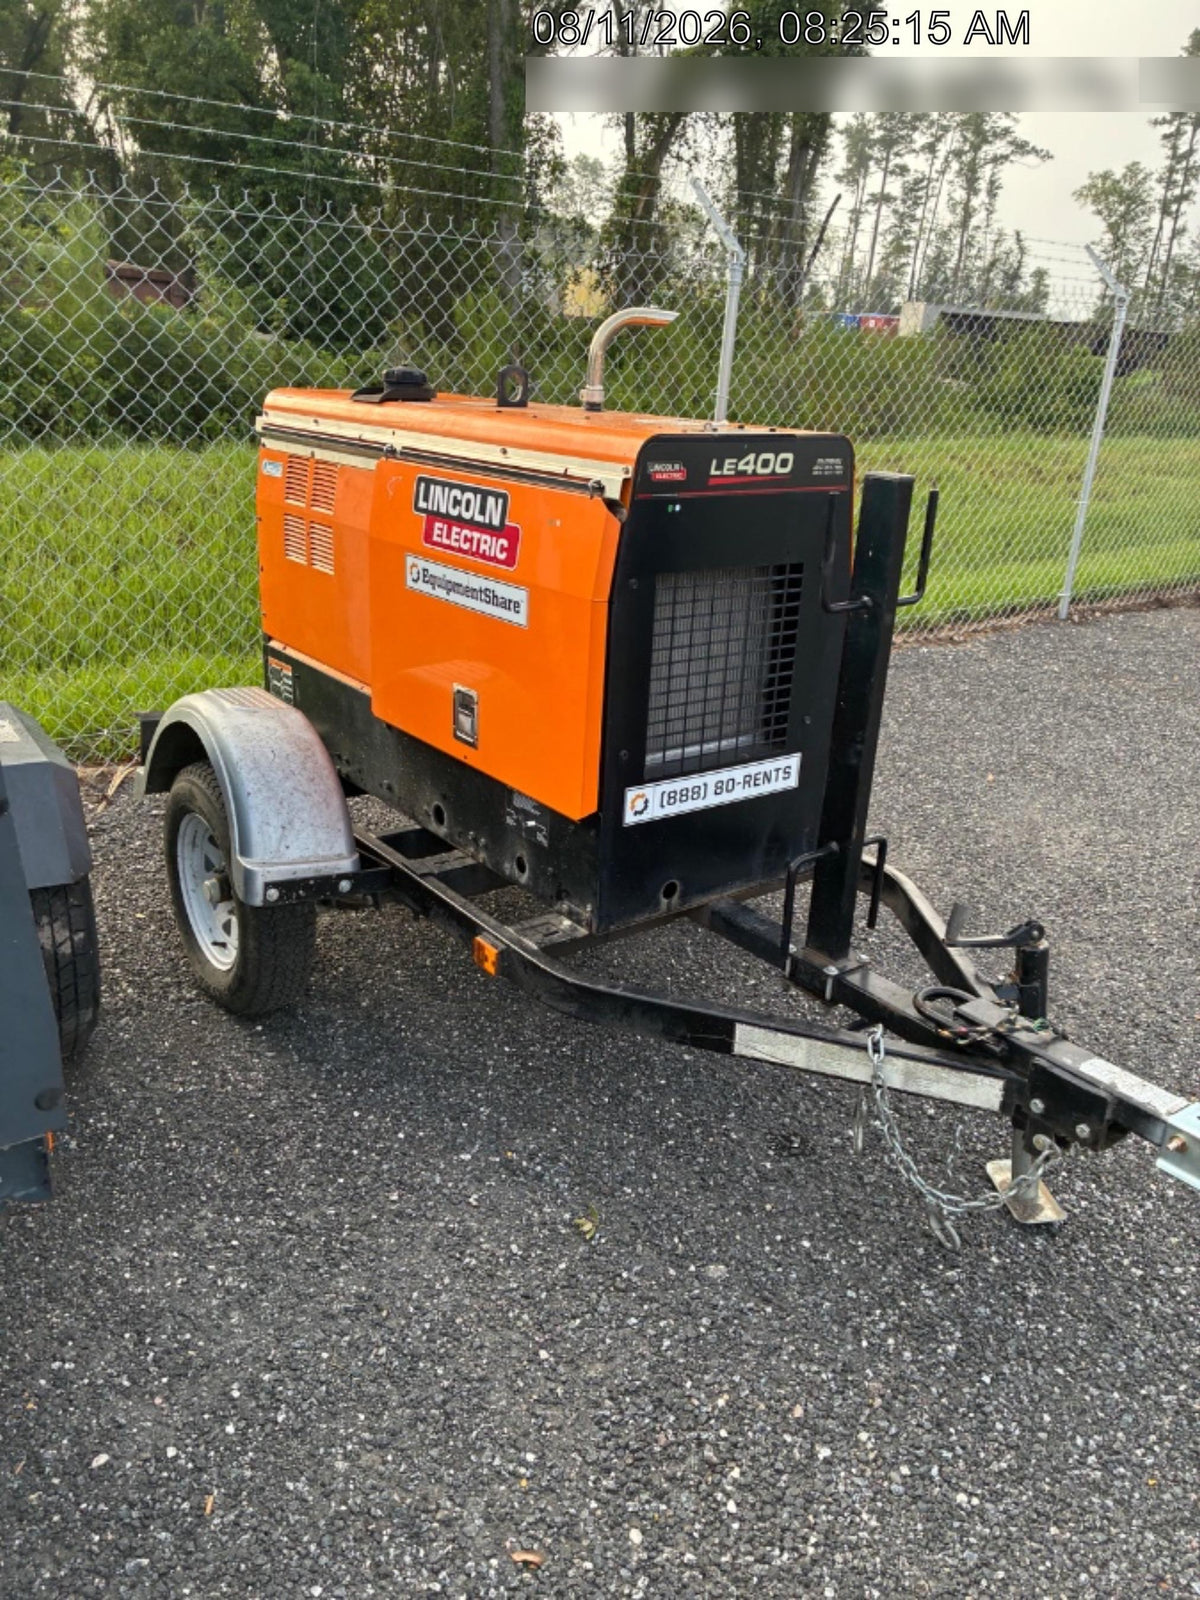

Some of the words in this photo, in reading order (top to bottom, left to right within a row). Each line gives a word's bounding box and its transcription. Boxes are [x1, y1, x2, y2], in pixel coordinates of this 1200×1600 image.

[709, 453, 794, 476] LE400
[417, 482, 504, 527] LINCOLN
[432, 522, 509, 560] ELECTRIC
[421, 568, 521, 614] EquipmentShare
[659, 783, 708, 808] (888)
[714, 766, 792, 796] 80-RENTS
